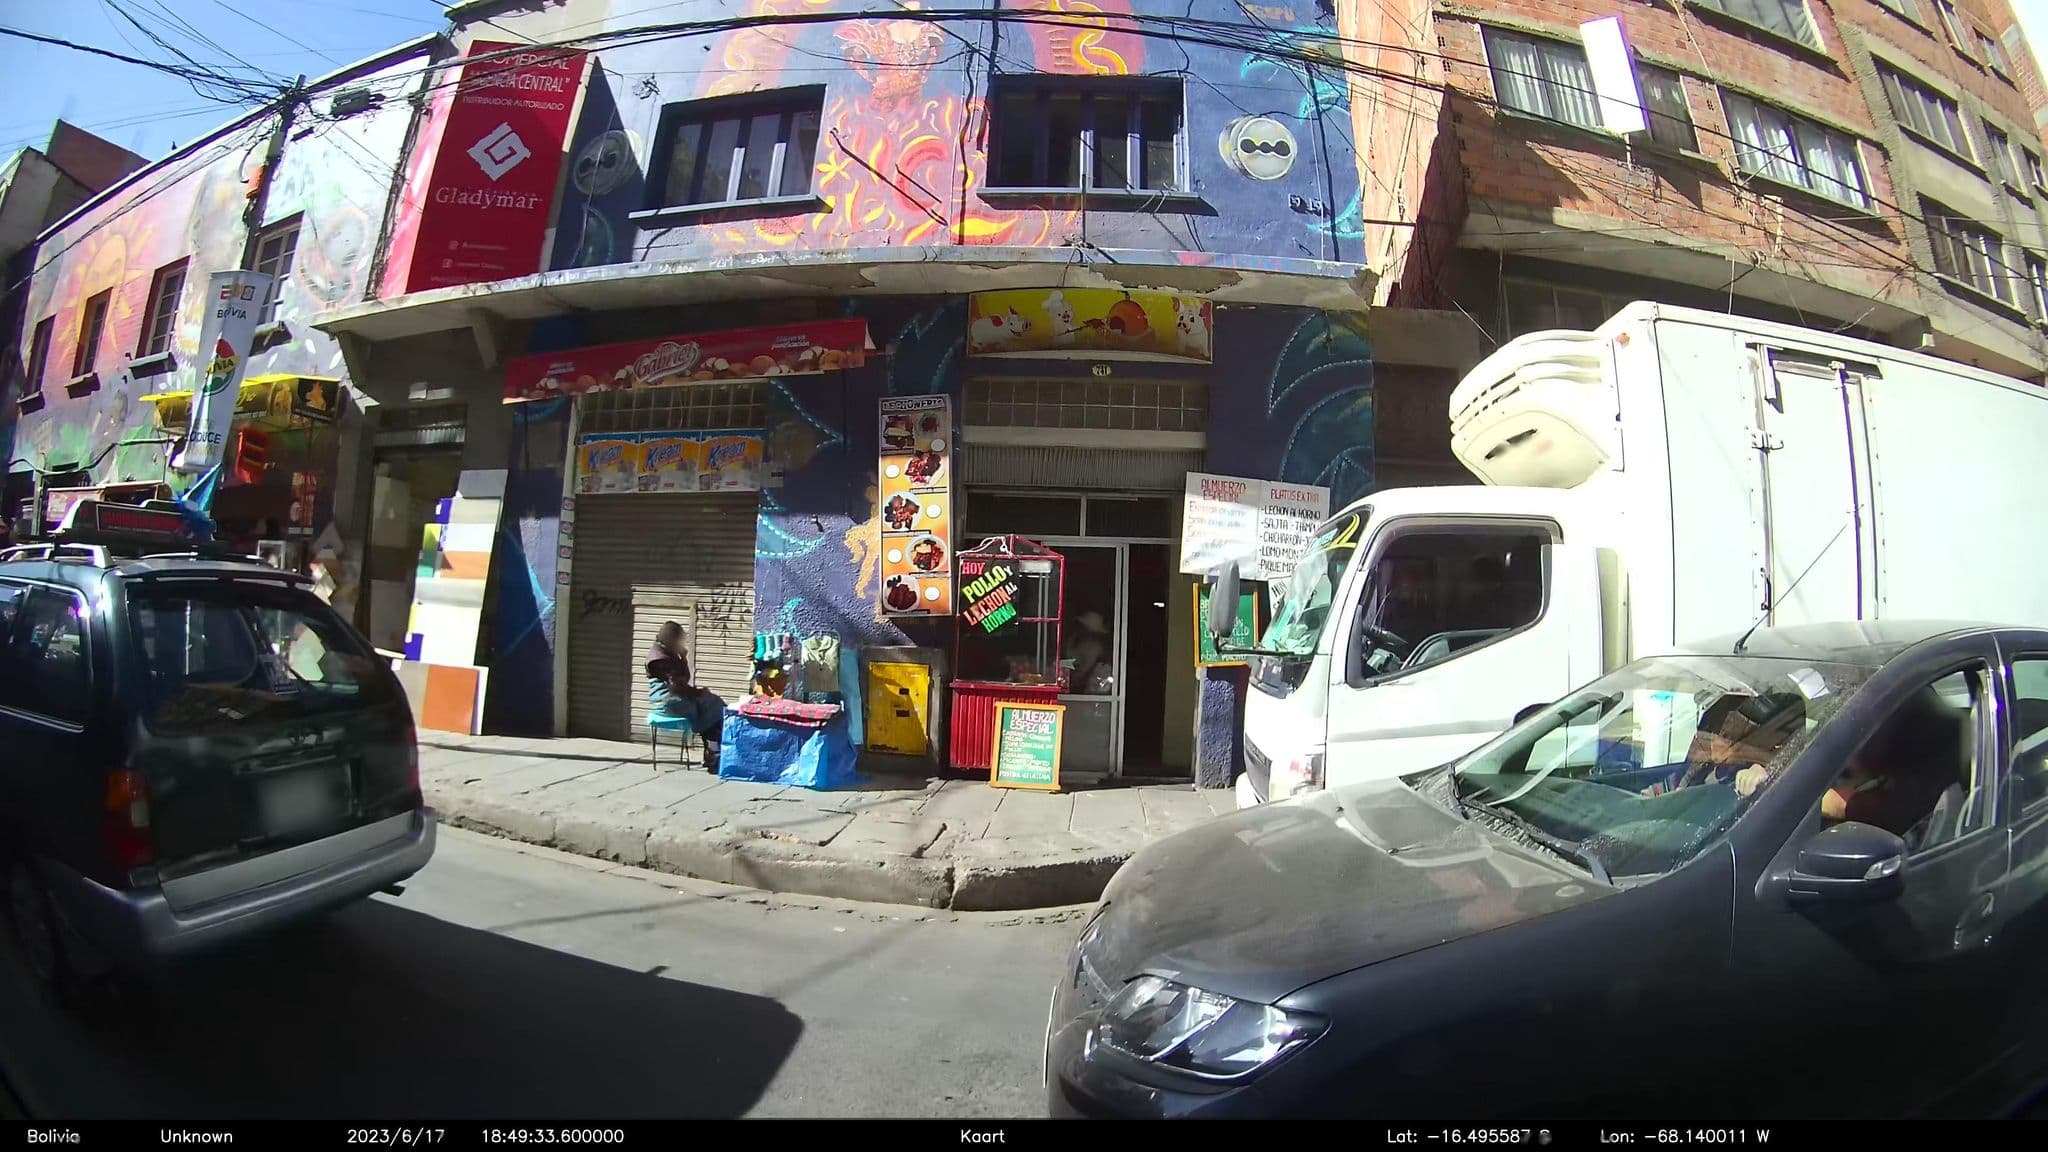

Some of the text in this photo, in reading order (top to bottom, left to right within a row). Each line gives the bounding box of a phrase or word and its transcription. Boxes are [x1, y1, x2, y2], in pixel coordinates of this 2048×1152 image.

[435, 187, 542, 210] Gladymar
[1201, 478, 1247, 495] ALMUERZO
[962, 562, 985, 575] HOY
[962, 565, 1014, 603] POLLO Y
[963, 581, 1018, 626] LECHON AL
[981, 602, 1017, 633] HORNO
[1011, 709, 1056, 724] ALMUERZO
[1009, 720, 1054, 735] ESPECIAL
